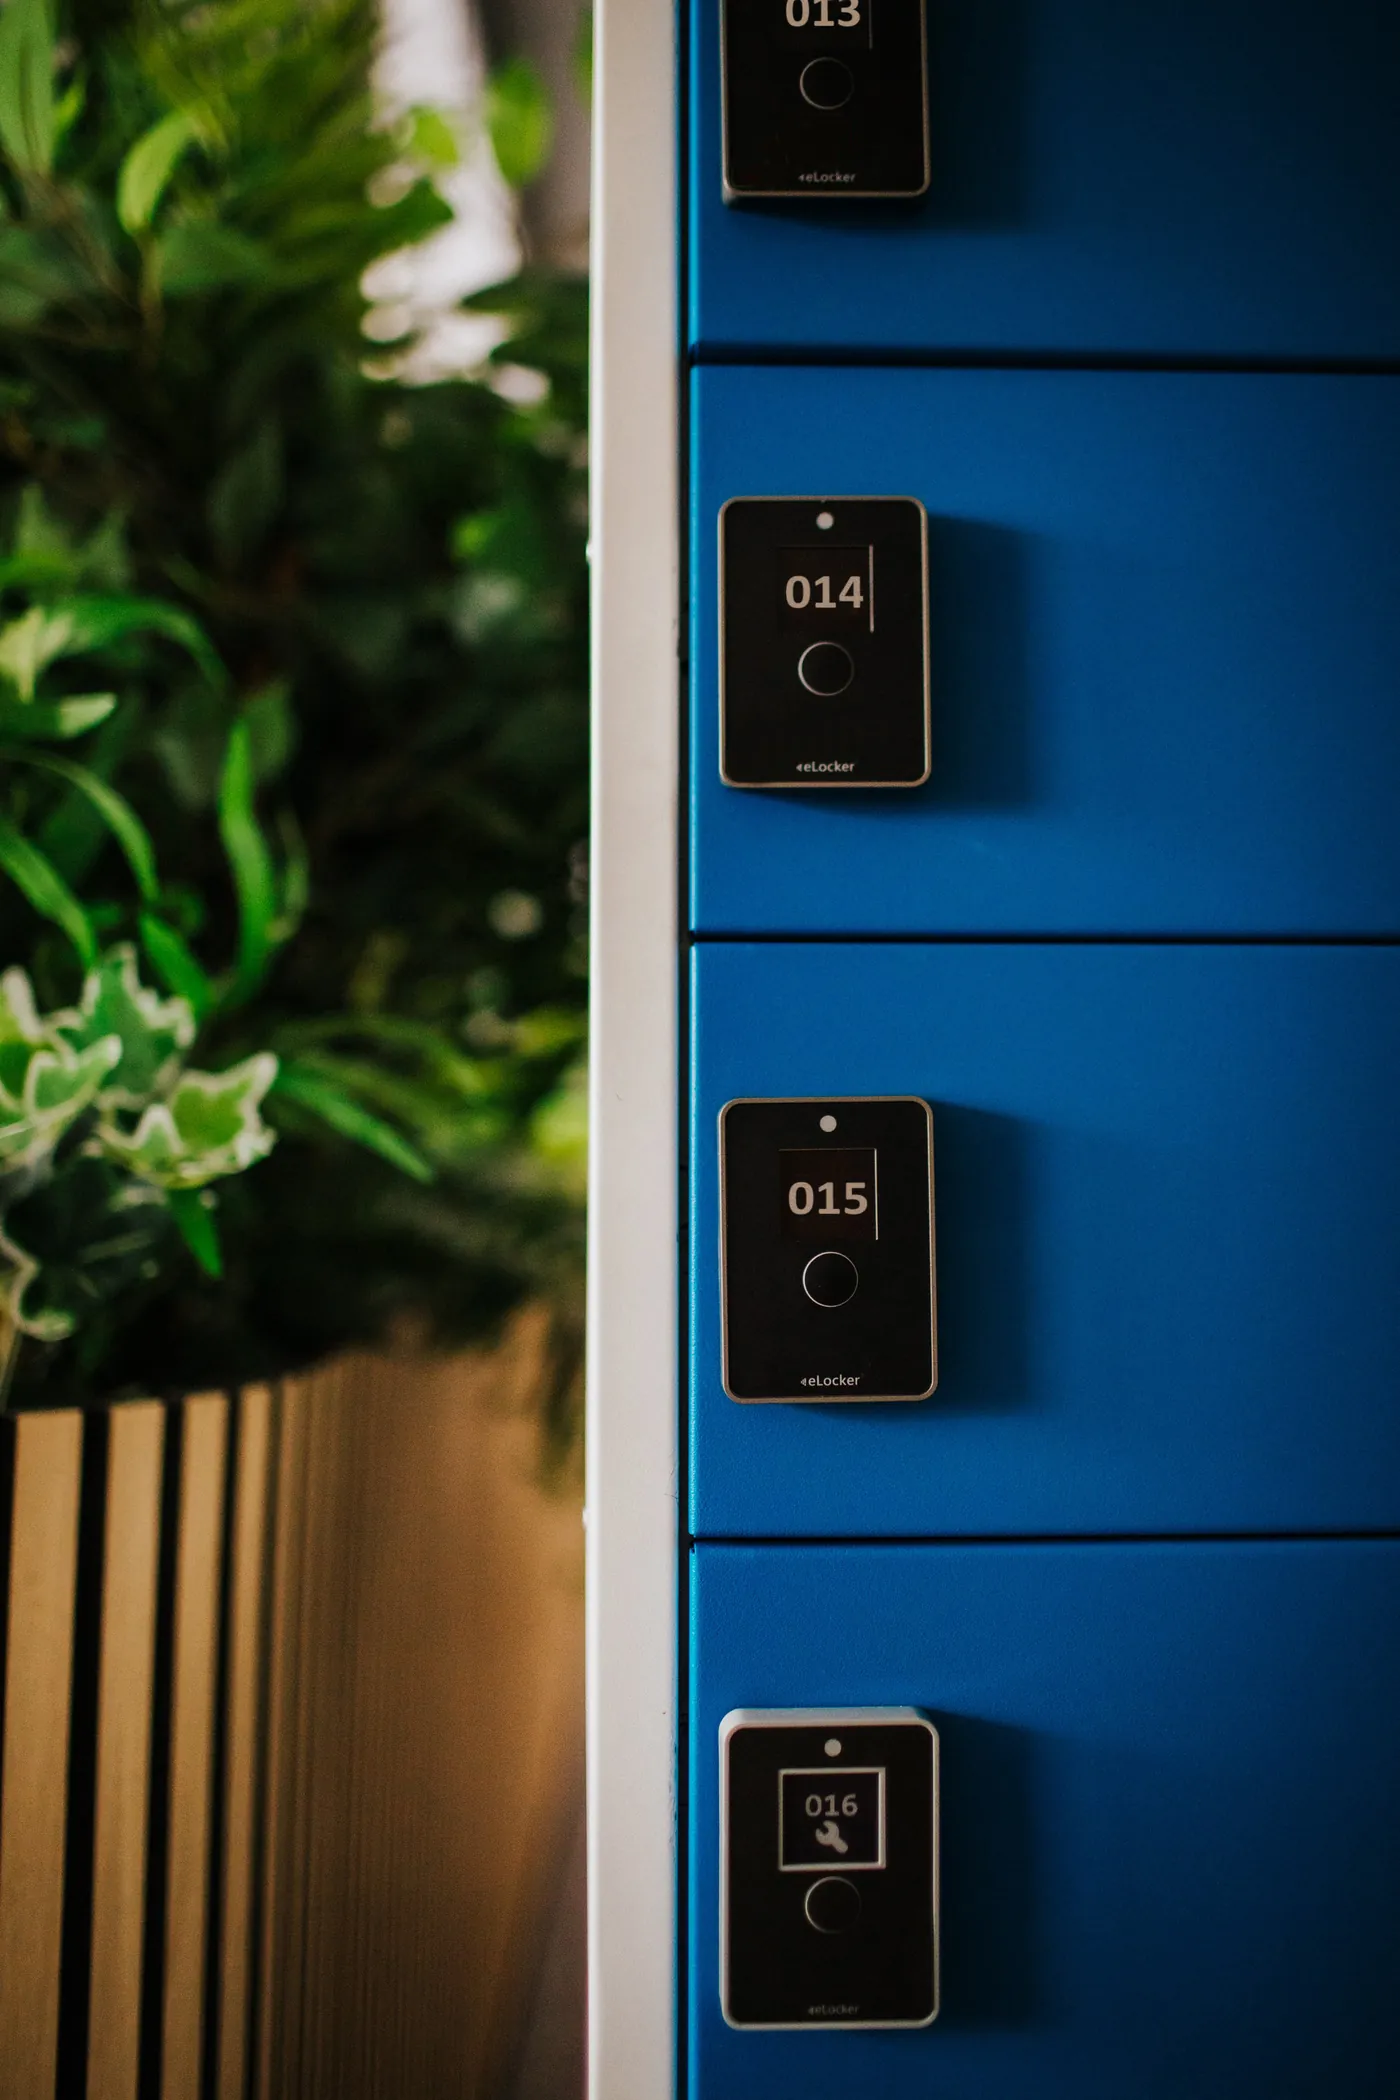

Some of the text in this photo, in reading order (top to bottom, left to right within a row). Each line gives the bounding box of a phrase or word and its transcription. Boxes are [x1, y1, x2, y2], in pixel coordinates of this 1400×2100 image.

[785, 0, 861, 27] 013
[805, 171, 857, 183] eLocker
[785, 576, 864, 609] 014
[803, 760, 855, 773] eLocker
[788, 1181, 867, 1215] 015
[808, 1374, 861, 1387] eLocker
[805, 1794, 858, 1817] 016
[812, 2003, 860, 2016] eLocker
